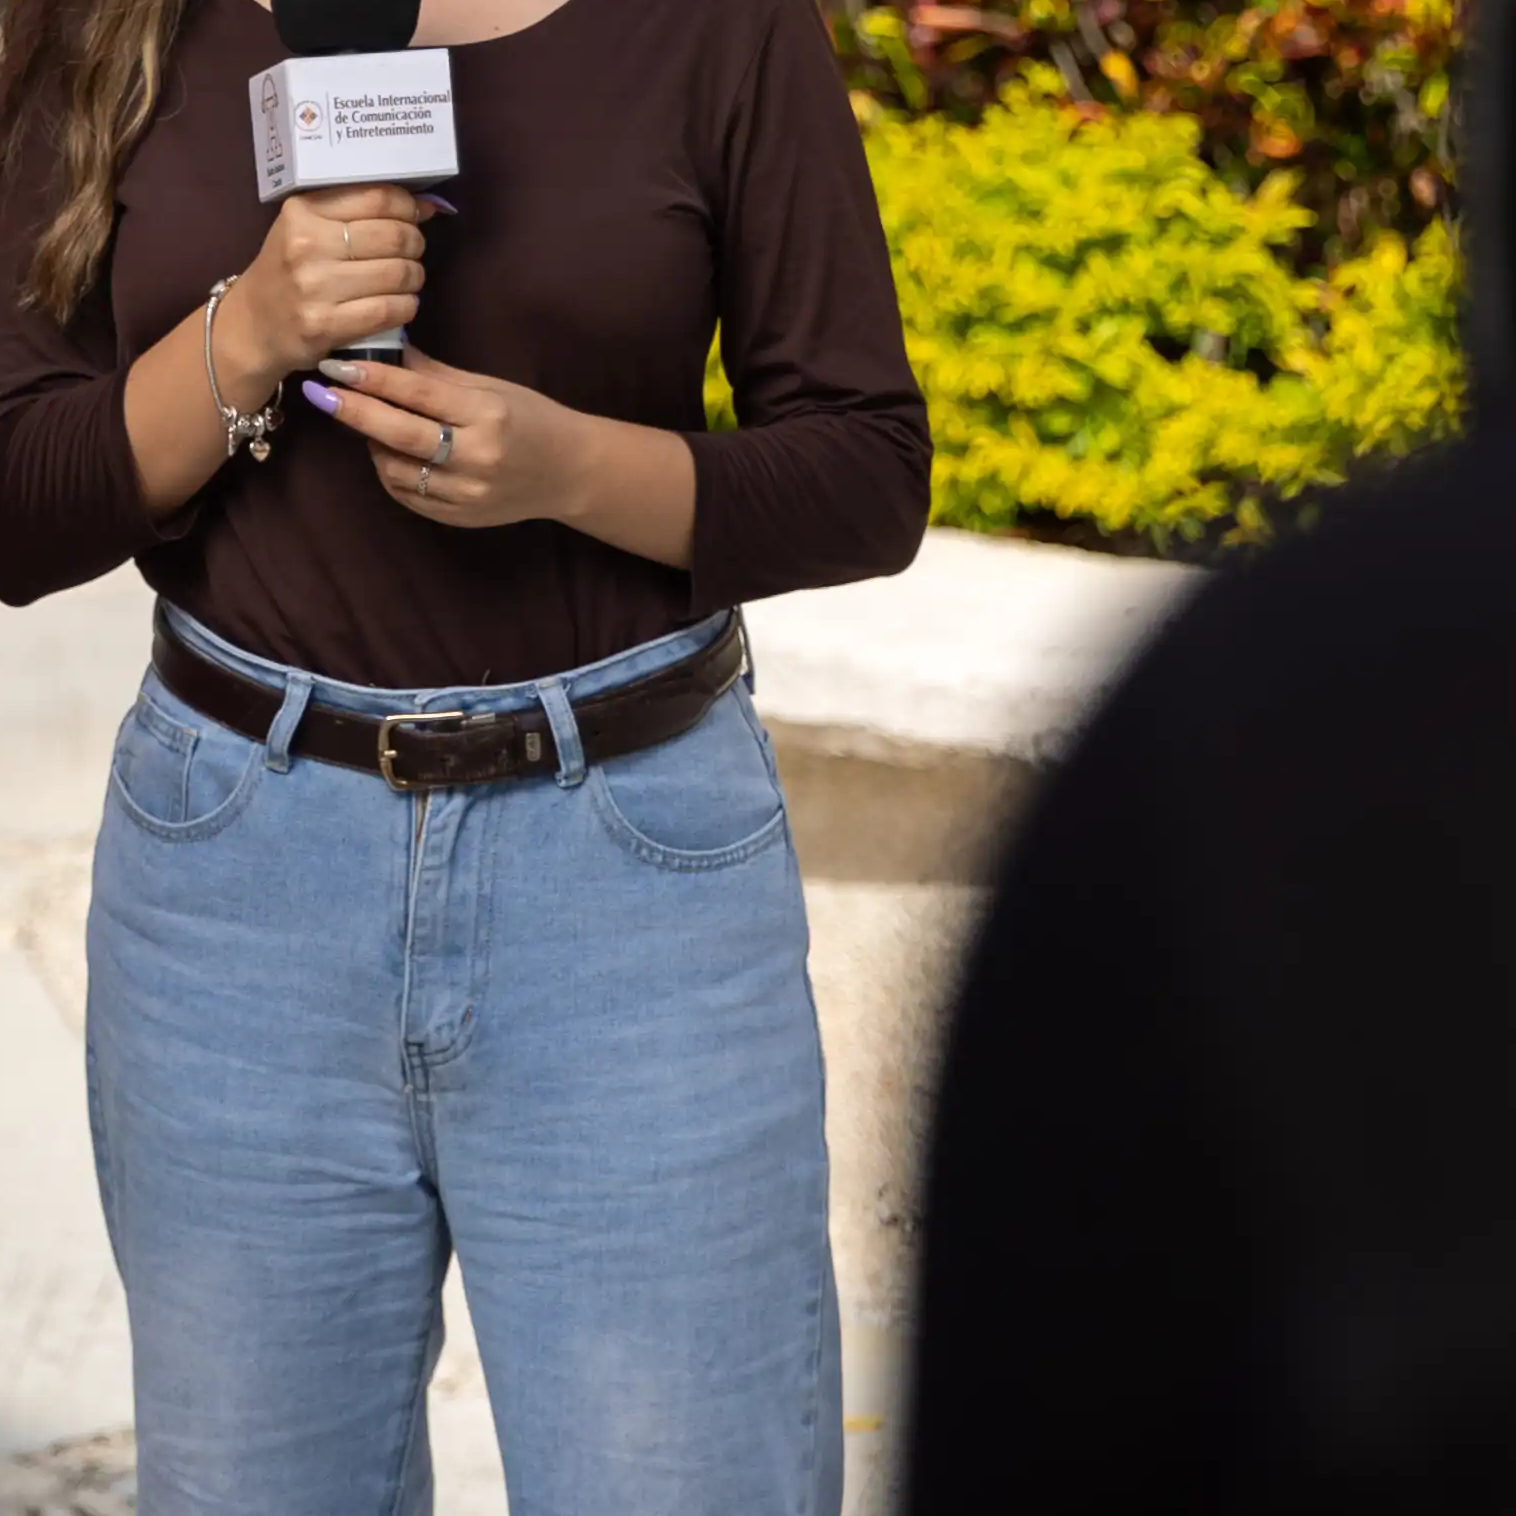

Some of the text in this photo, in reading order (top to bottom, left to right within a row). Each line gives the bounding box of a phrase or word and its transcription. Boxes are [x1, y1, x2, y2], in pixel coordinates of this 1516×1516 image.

[333, 90, 450, 110] Escuela Internacional
[334, 106, 432, 124] de Comunicación
[336, 130, 343, 143] y
[346, 122, 434, 139] Entretenimiento
